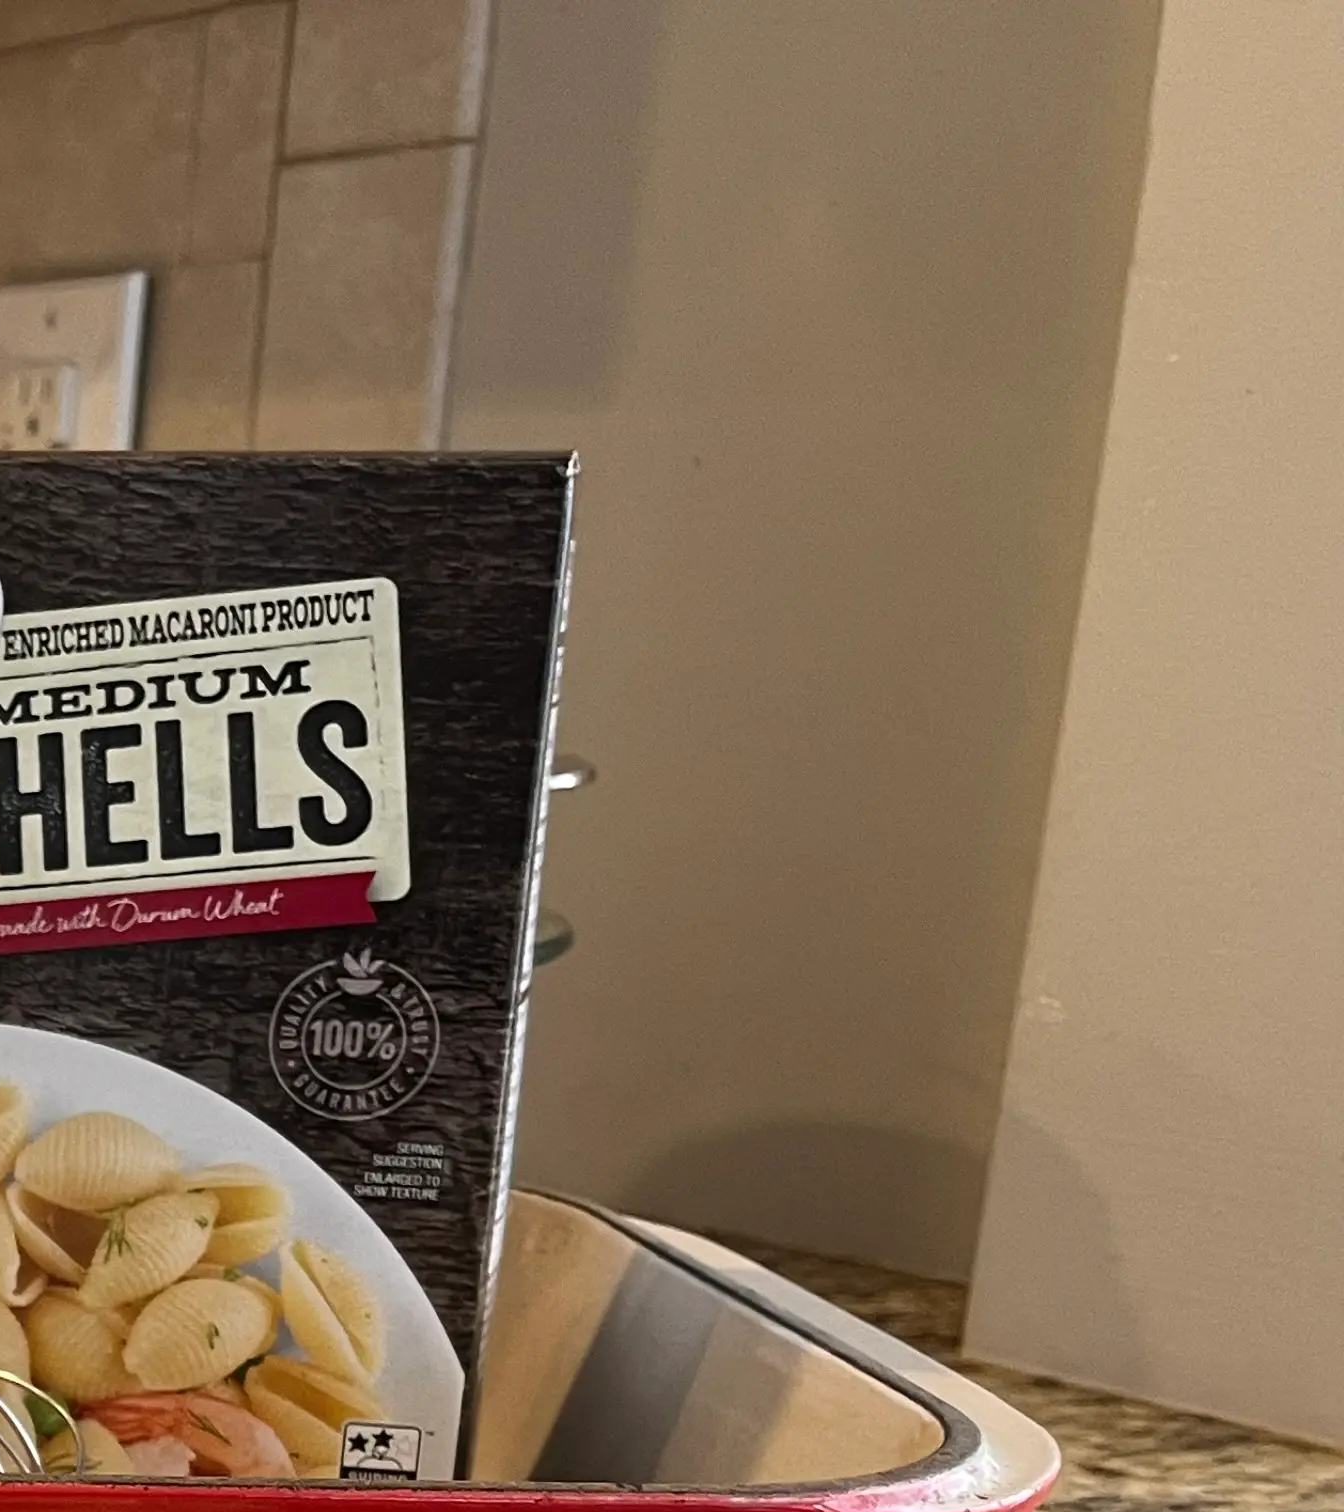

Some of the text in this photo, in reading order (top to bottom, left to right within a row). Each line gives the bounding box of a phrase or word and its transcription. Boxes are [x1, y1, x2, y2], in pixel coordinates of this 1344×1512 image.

[2, 589, 375, 661] ENRICHED MACARONI PRODUCT
[57, 903, 106, 933] with
[107, 897, 200, 932] Durum
[204, 887, 284, 921] Wheat
[279, 976, 327, 1049] QUALITY
[310, 1020, 396, 1060] 100%
[293, 1073, 406, 1112] GUARANTEE
